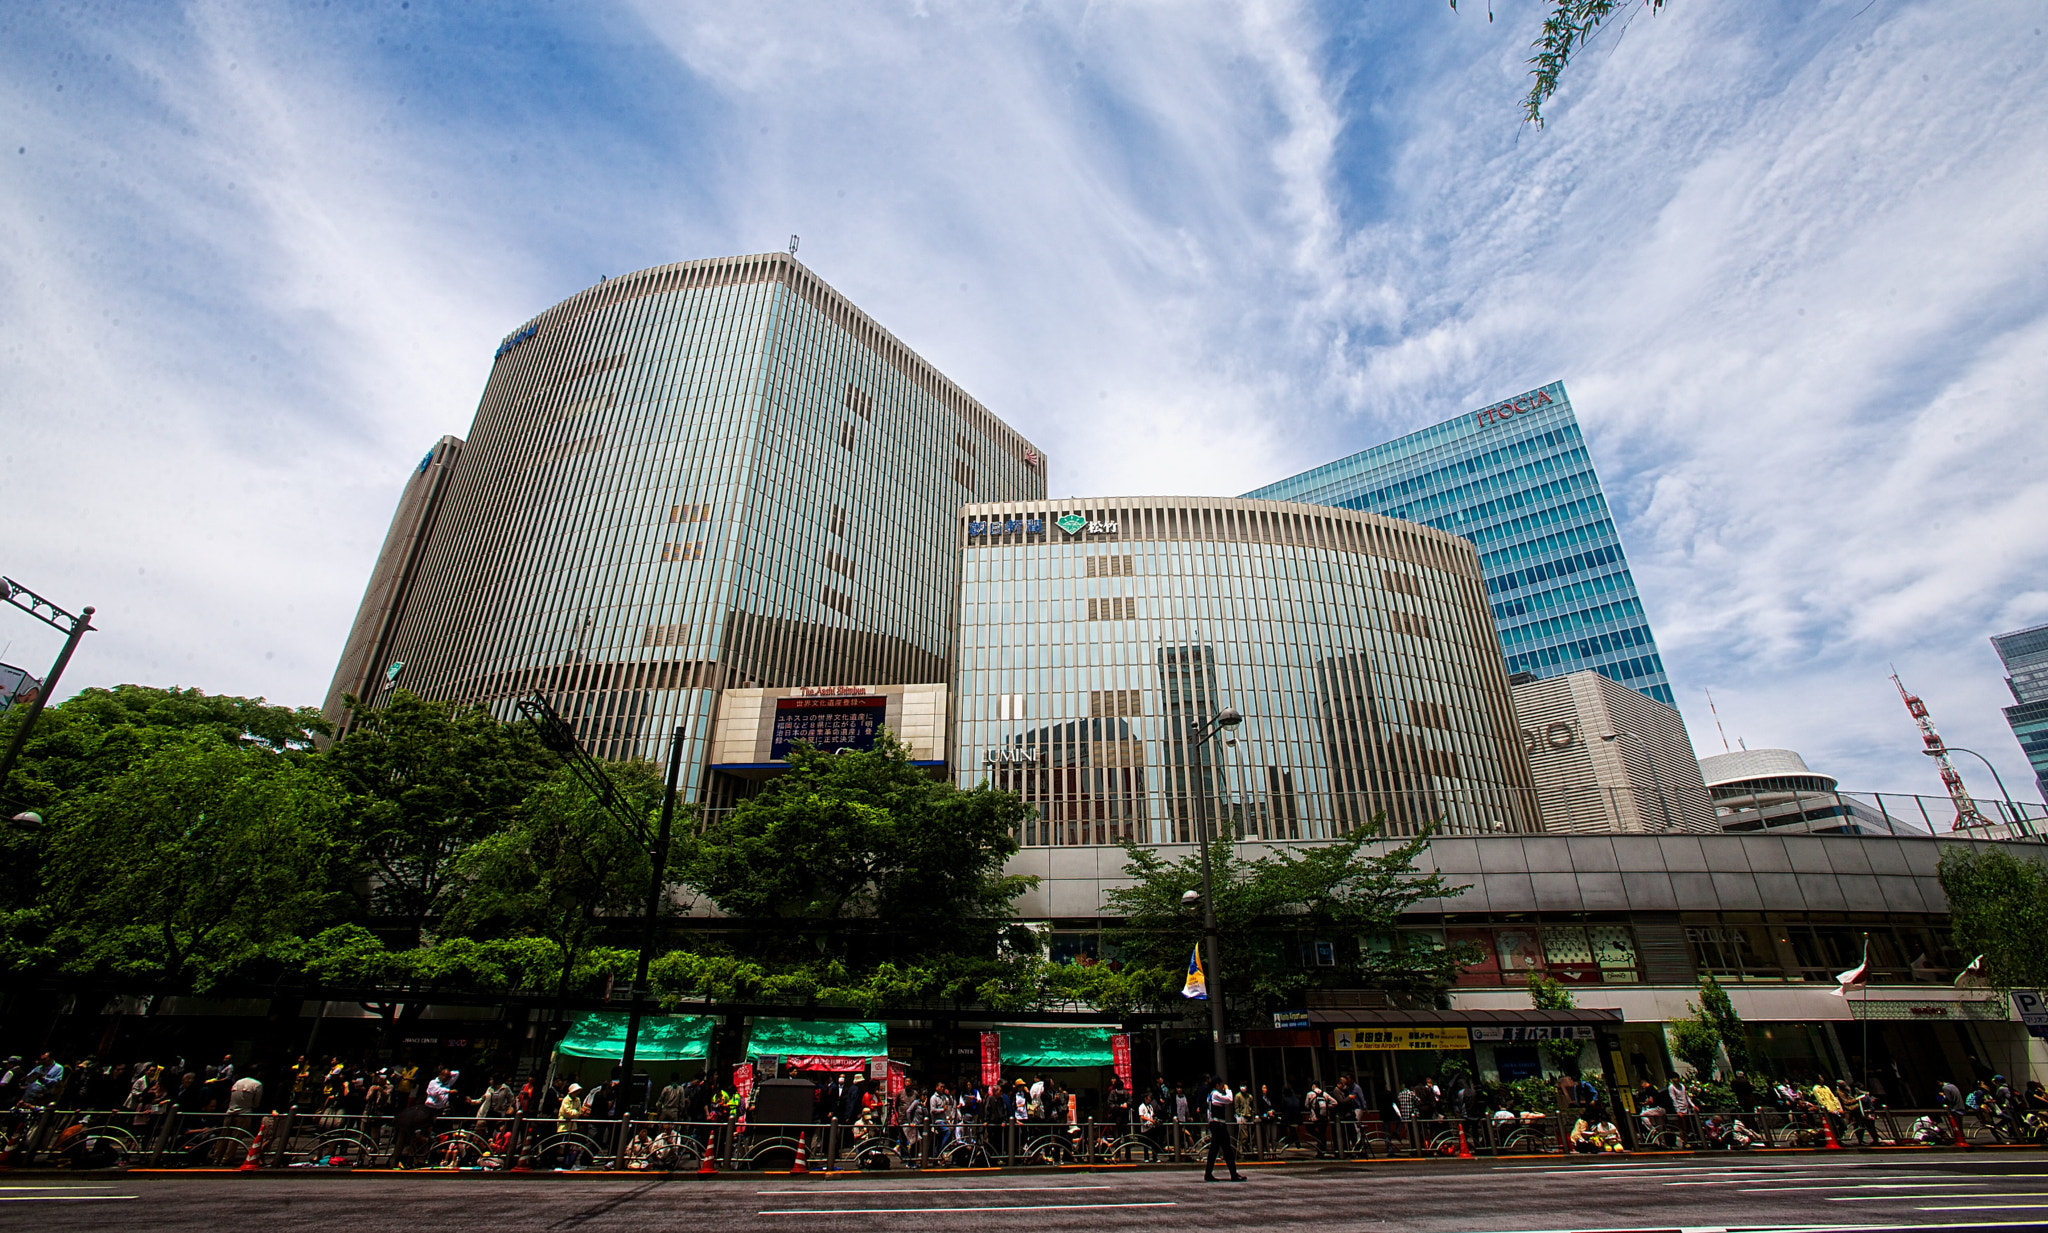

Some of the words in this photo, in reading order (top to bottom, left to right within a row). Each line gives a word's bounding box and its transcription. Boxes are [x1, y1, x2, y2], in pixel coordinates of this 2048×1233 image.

[968, 518, 1042, 537] 朝日新聞
[1088, 520, 1118, 534] 松竹
[800, 686, 815, 697] The
[815, 686, 836, 696] Asahi
[796, 698, 866, 708] 世界文化遺産登録へ
[778, 713, 873, 723] ユネスコの世界文化遺産に
[981, 747, 1040, 763] LUMINE
[1542, 929, 1578, 939] HELLO
[1545, 939, 1581, 950] KITTY
[2018, 995, 2036, 1012] P
